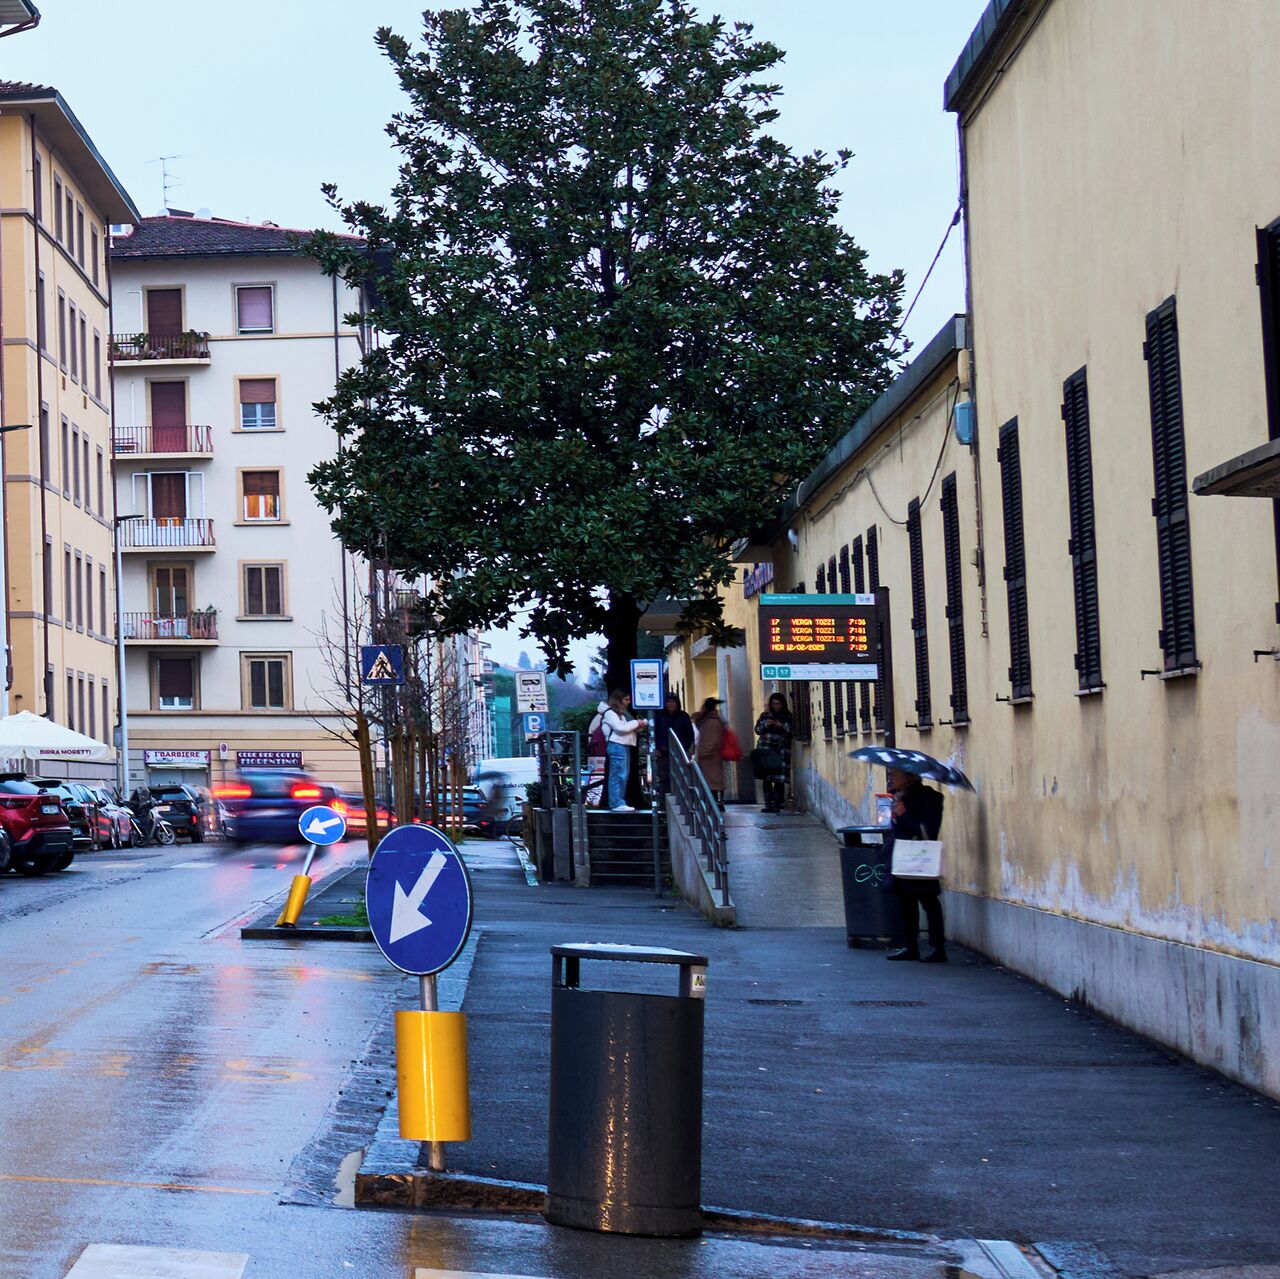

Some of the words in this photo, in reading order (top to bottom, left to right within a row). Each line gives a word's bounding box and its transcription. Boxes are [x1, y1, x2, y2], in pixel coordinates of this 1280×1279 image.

[771, 618, 780, 626] 17
[791, 618, 813, 626] VERGA
[814, 618, 836, 626] TOZZI
